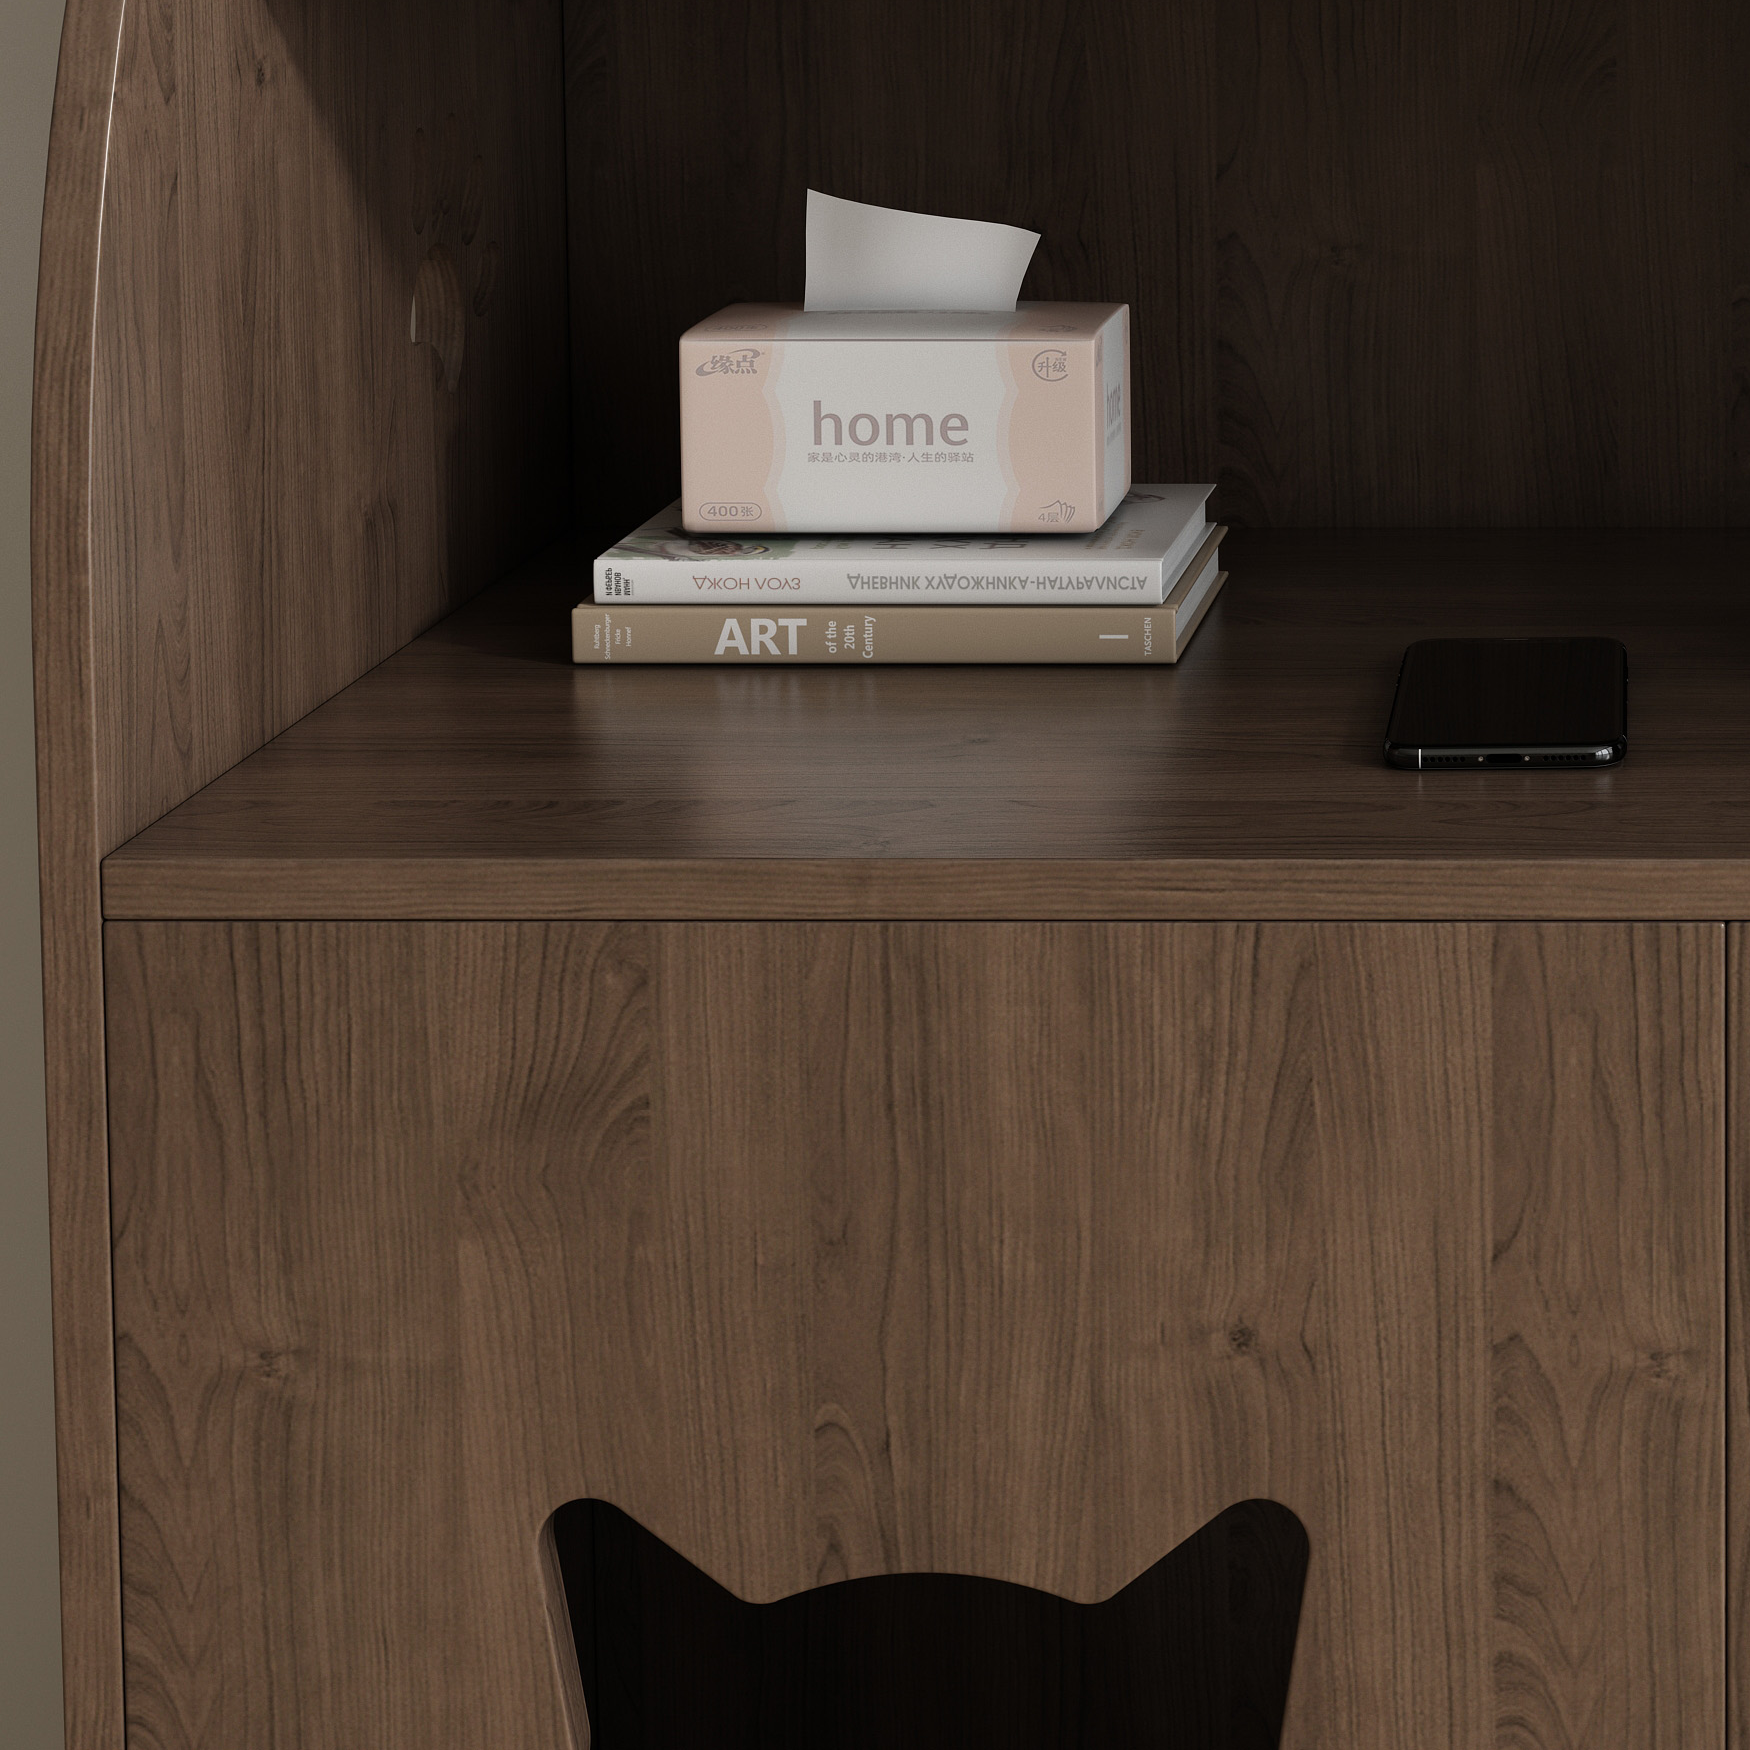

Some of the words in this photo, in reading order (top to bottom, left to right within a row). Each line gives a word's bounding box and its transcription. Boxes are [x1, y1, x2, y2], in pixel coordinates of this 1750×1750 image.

[1038, 357, 1067, 378] 升级
[813, 400, 969, 446] home
[714, 618, 808, 655] ART
[825, 620, 837, 638] the
[844, 624, 855, 650] 20th
[862, 615, 877, 659] Century
[1143, 617, 1152, 656] TASCHEN
[825, 640, 837, 654] of
